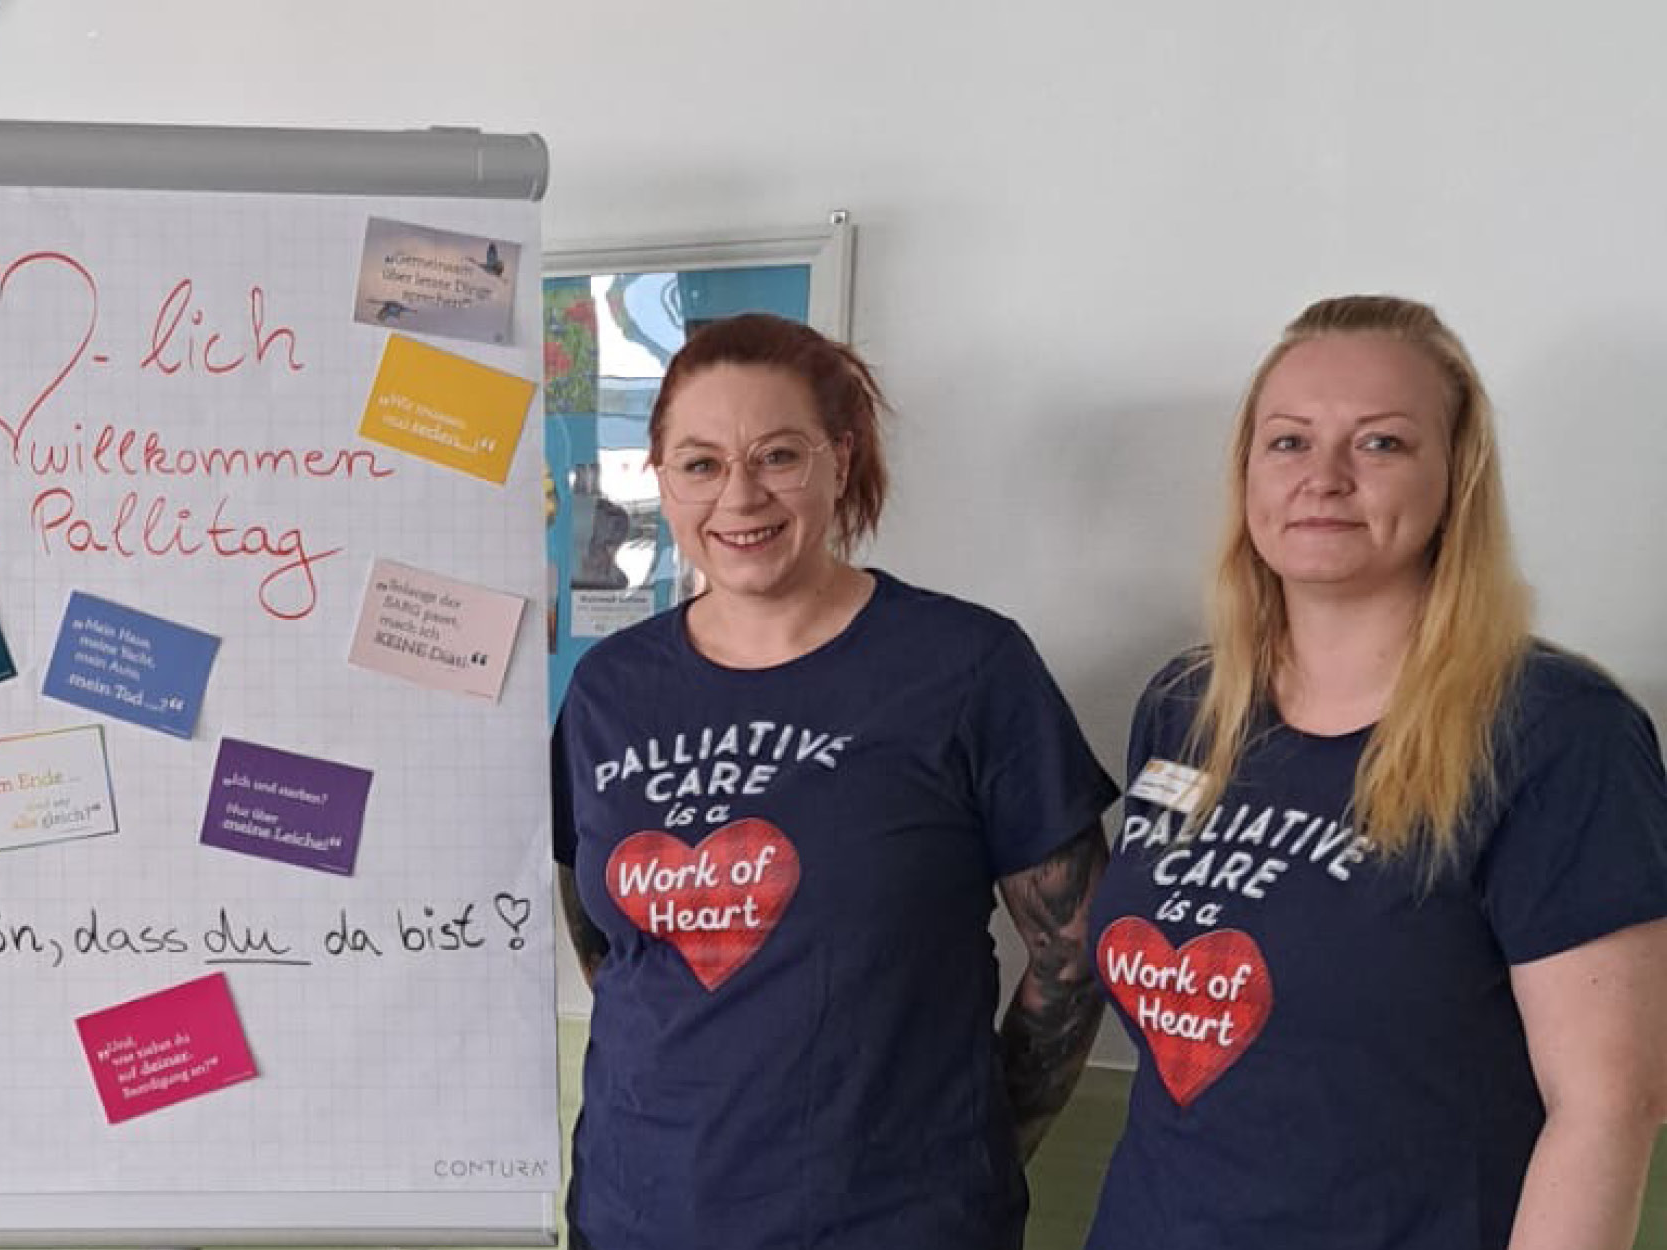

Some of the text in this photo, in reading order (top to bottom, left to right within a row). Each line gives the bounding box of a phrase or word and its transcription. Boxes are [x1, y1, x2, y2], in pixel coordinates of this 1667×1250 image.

[30, 422, 395, 478] willkommen
[30, 487, 344, 619] Pallitag
[374, 630, 429, 658] KEINE
[418, 625, 440, 641] ich
[69, 673, 111, 697] mein
[112, 684, 144, 707] Tod
[594, 720, 854, 793] PALLIATIVE
[17, 768, 63, 790] Ende
[253, 780, 278, 795] und
[645, 760, 779, 803] CARE
[222, 818, 272, 839] meine
[225, 801, 250, 818] Nur
[664, 800, 732, 829] is a
[617, 844, 777, 898] Work of
[1152, 849, 1289, 899] CARE
[648, 895, 762, 934] Heart
[1155, 889, 1224, 927] is a
[74, 907, 190, 955] dass
[204, 906, 294, 956] du
[324, 908, 383, 957] da
[1105, 947, 1253, 1001] Work of
[173, 1031, 191, 1047] du
[1136, 994, 1235, 1048] Heart
